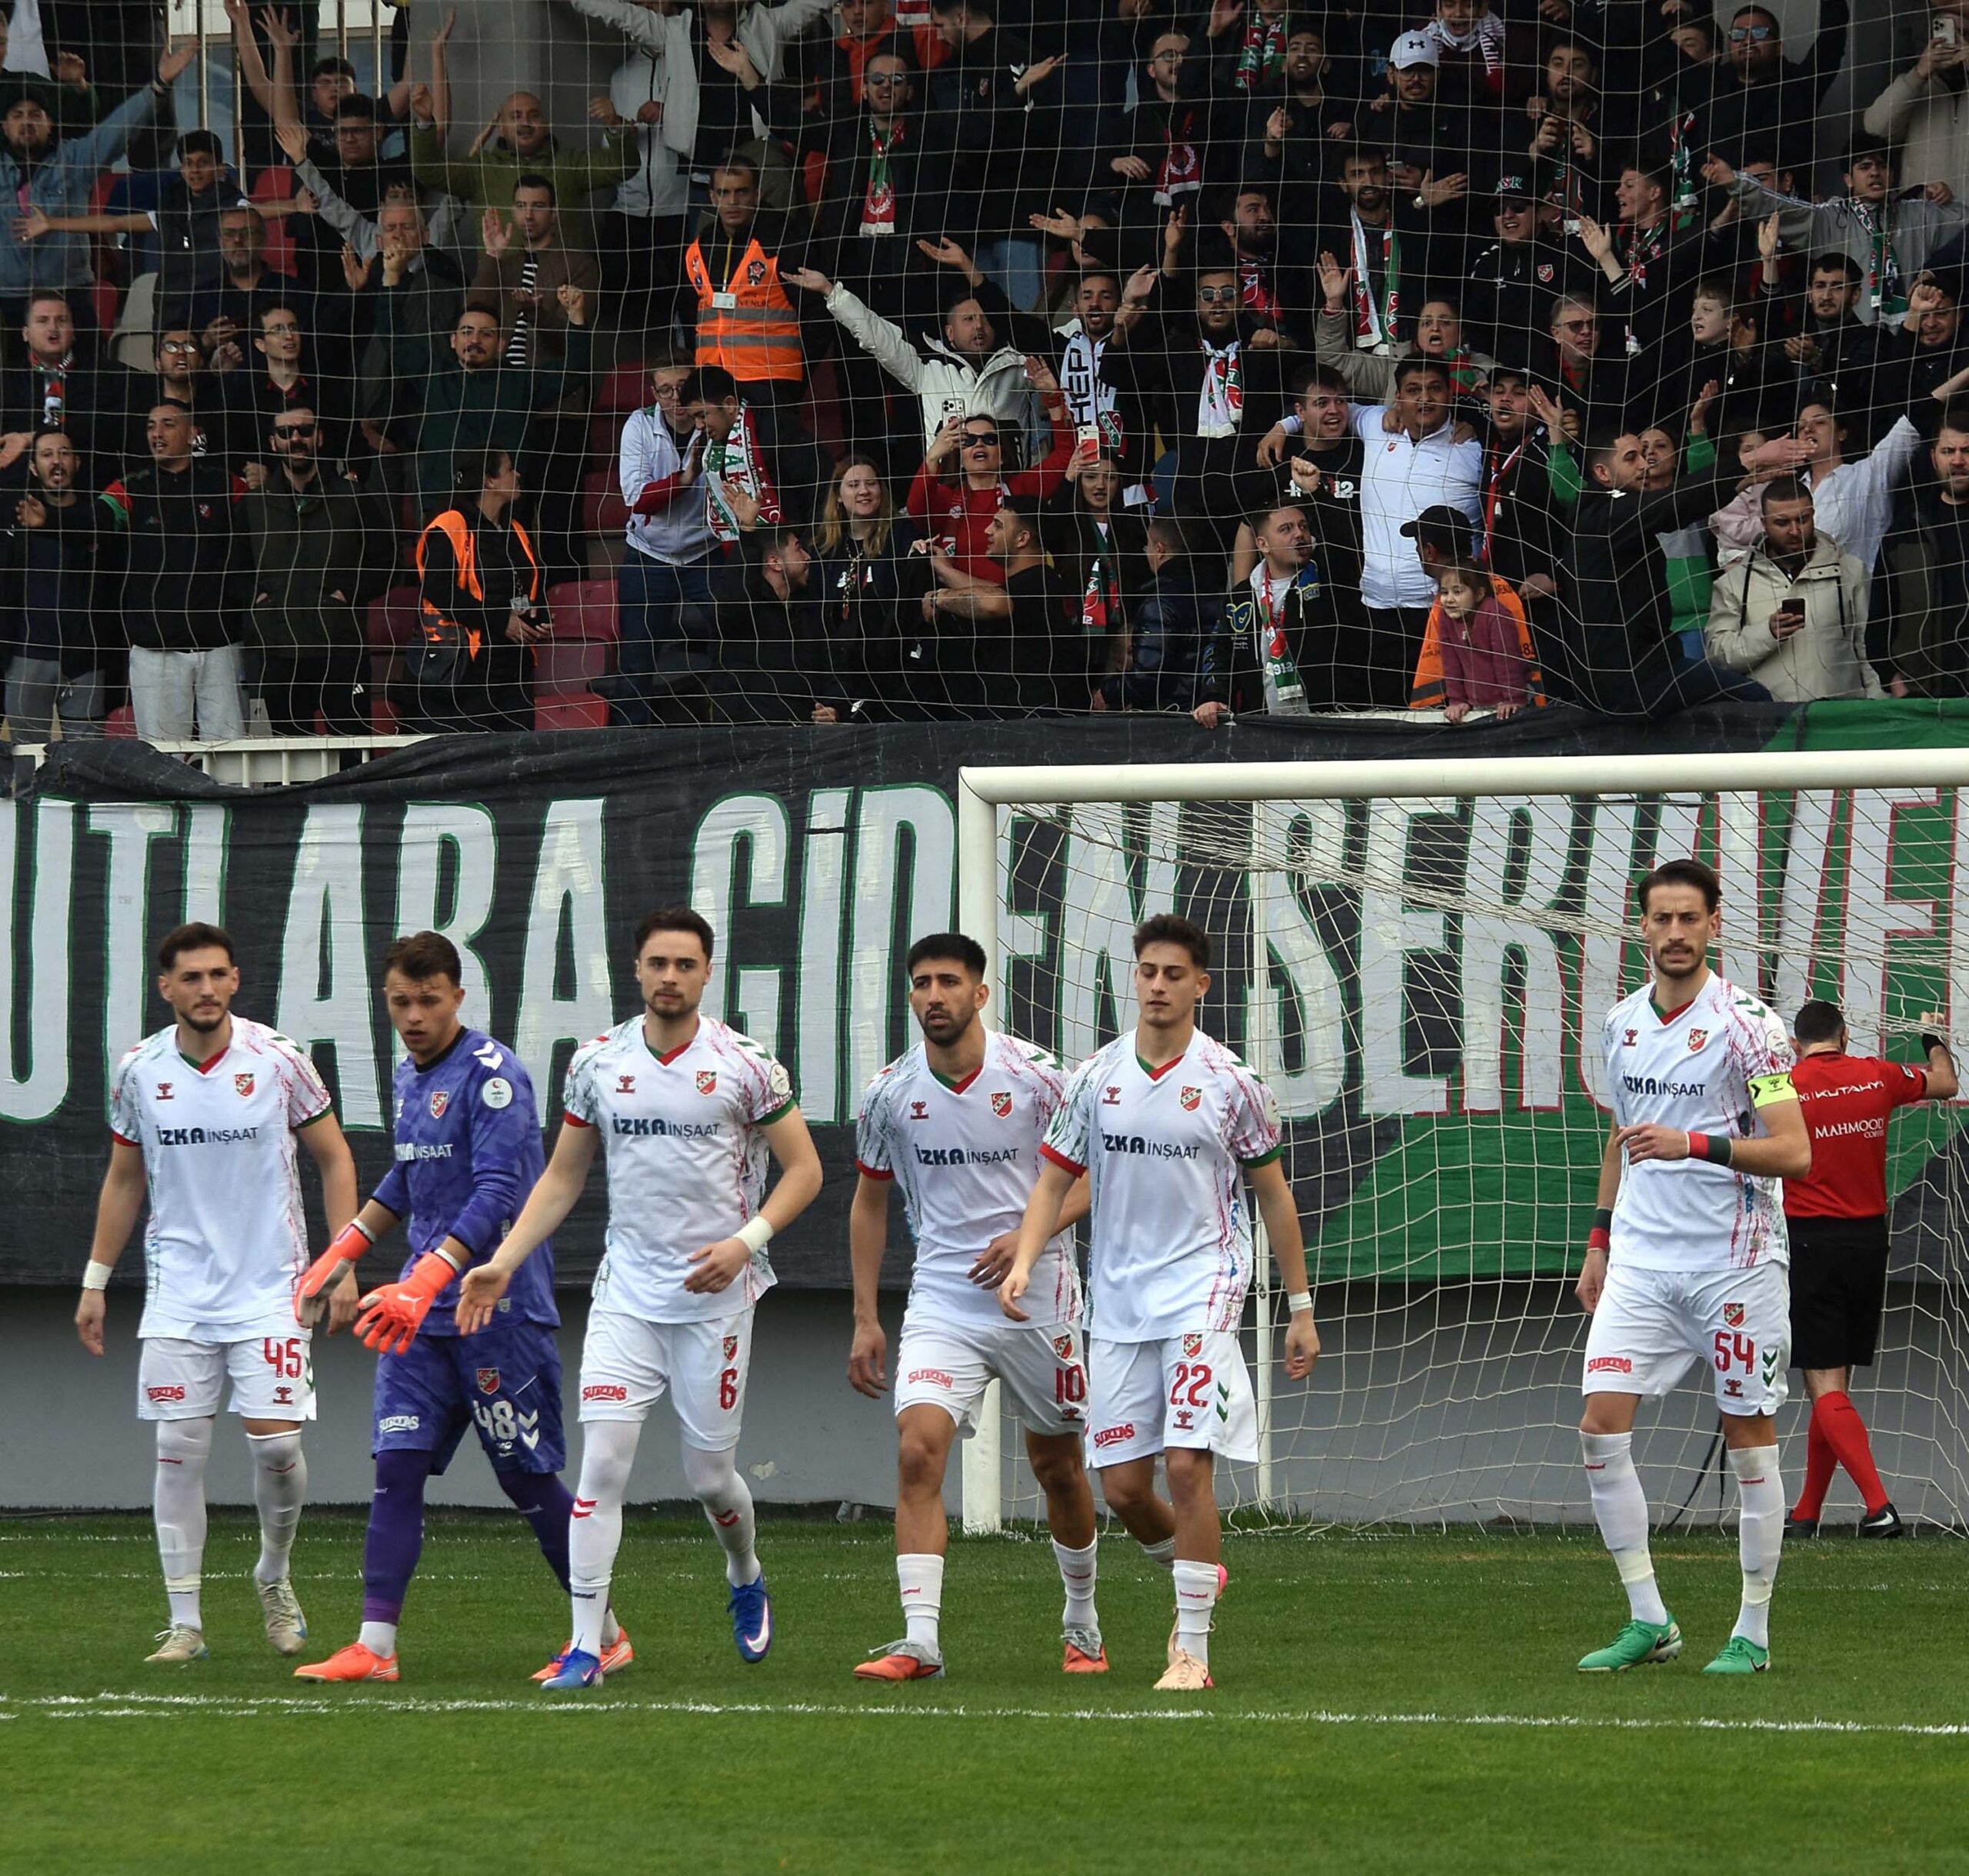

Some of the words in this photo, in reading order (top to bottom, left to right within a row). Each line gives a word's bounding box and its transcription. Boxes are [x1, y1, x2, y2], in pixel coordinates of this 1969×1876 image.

[1657, 1080, 1706, 1099] İNŞAAT
[155, 1125, 206, 1146] İZKA
[206, 1127, 259, 1145] İNŞAAT
[612, 1112, 667, 1136] İZKA
[668, 1121, 721, 1139] İNŞAAT
[1815, 1118, 1884, 1139] MAHMOOD
[914, 1143, 966, 1165] İZKA
[966, 1148, 1019, 1165] İNŞAAT
[1148, 1139, 1201, 1161] İNŞAAT
[264, 1338, 302, 1379] 45
[1714, 1331, 1754, 1375] 54
[720, 1368, 738, 1411] 6
[1055, 1364, 1087, 1405] 10
[1170, 1364, 1213, 1408] 22
[473, 1400, 518, 1441] 48
